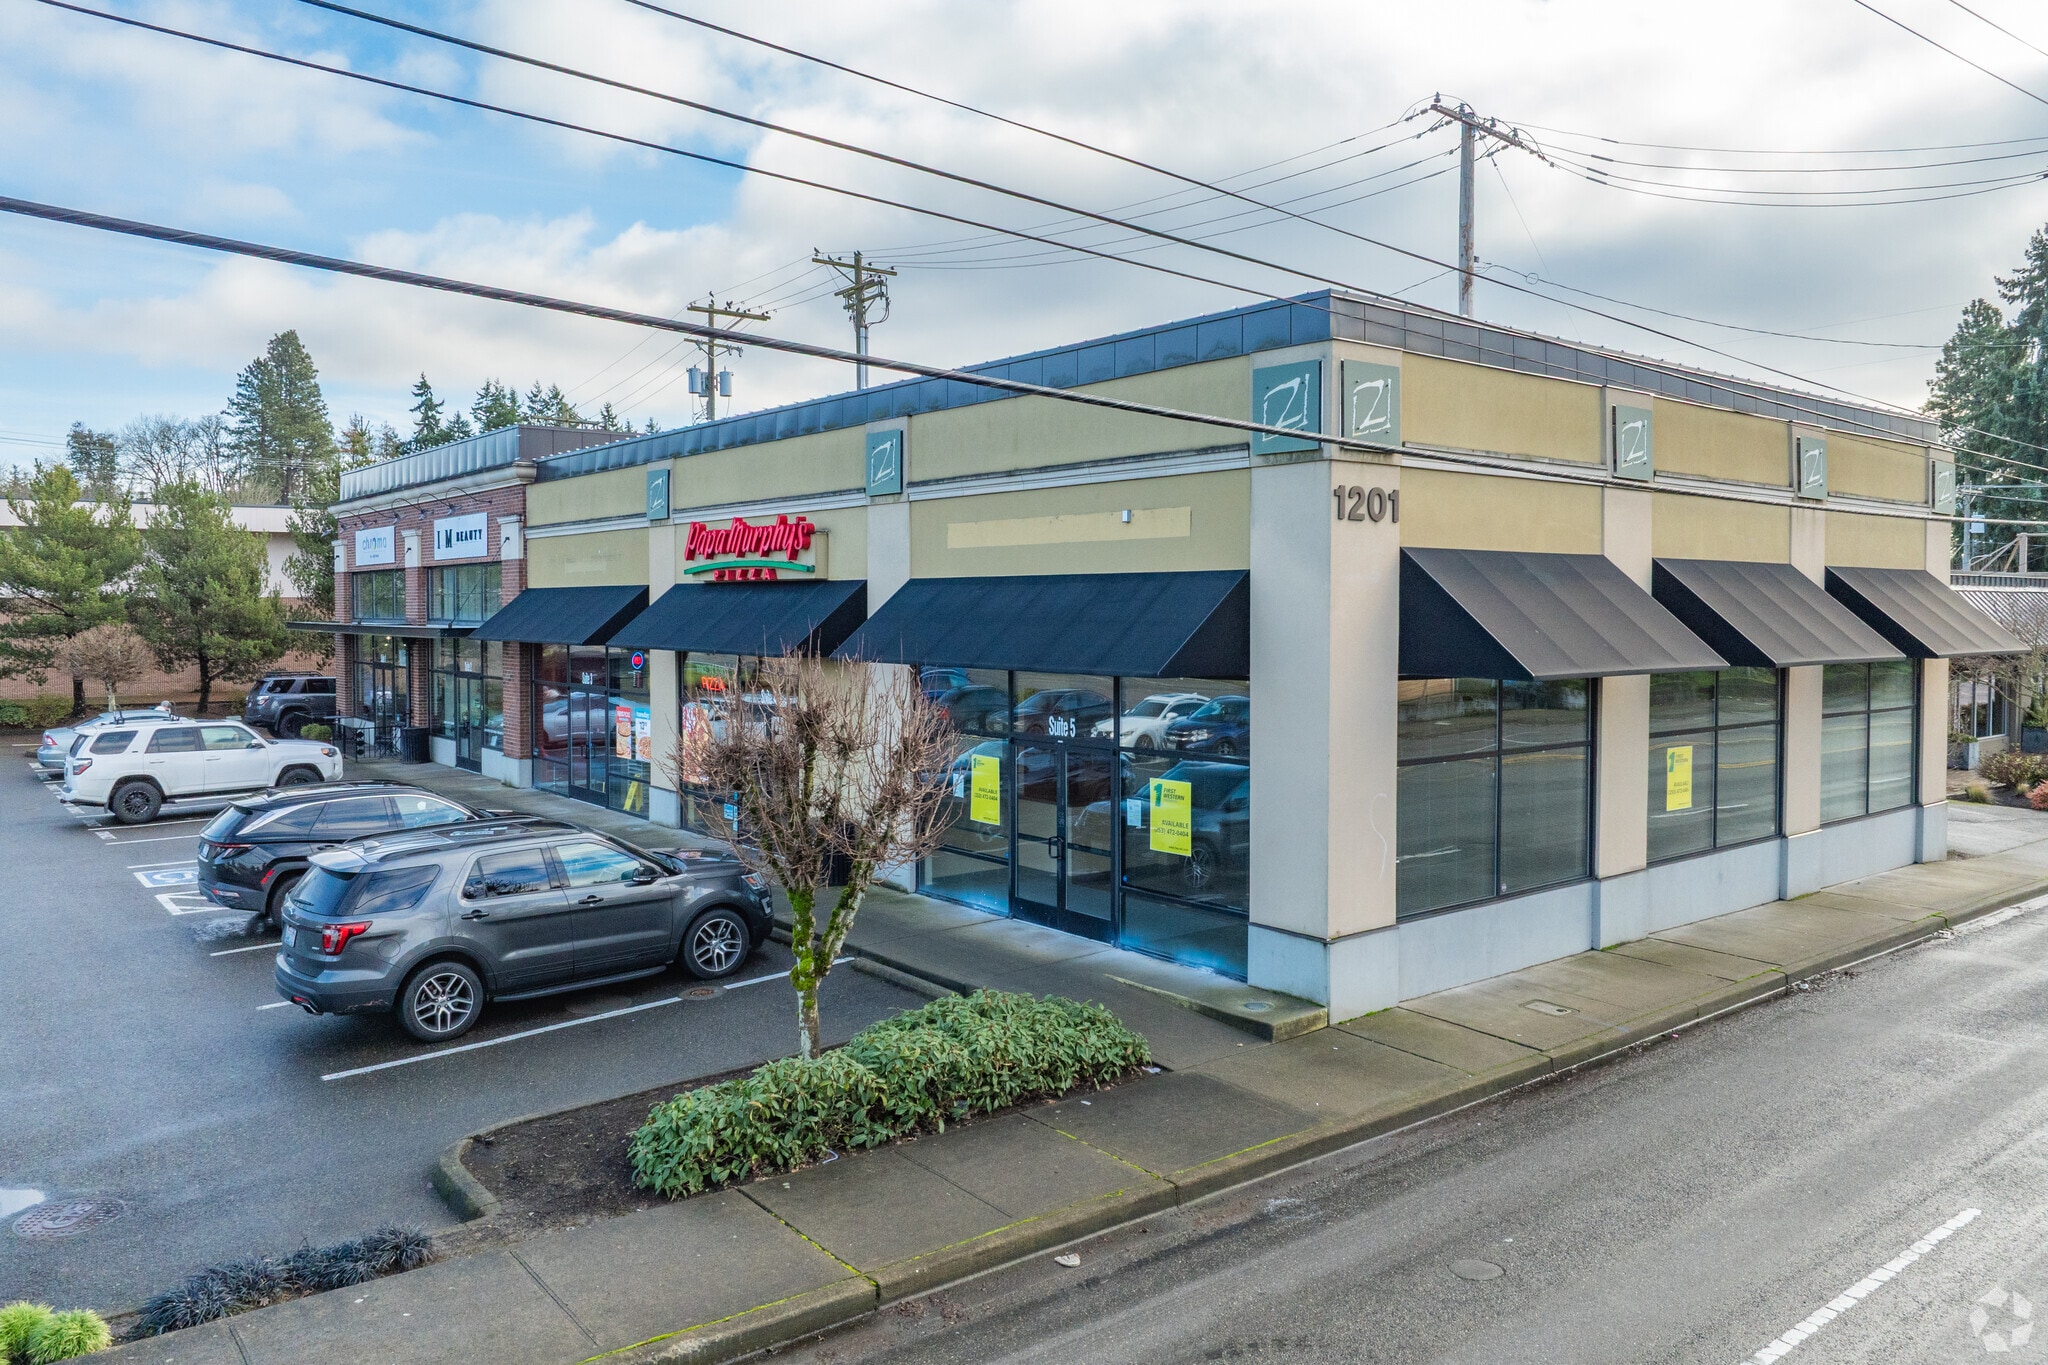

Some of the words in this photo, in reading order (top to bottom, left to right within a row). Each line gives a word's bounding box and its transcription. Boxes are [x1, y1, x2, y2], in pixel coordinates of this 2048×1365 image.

[1334, 484, 1400, 523] 1201
[362, 536, 388, 551] chroma
[437, 530, 441, 550] I
[444, 528, 454, 549] M
[456, 528, 483, 542] BEAUTY
[684, 521, 729, 561] Papa
[726, 514, 815, 561] Murphy's
[713, 568, 778, 581] PIZZA
[1048, 715, 1069, 737] Suite
[1070, 717, 1076, 738] 5
[1163, 793, 1185, 801] WESTERN
[1161, 819, 1189, 829] AVAILABLE
[1166, 828, 1189, 838] 472-0404
